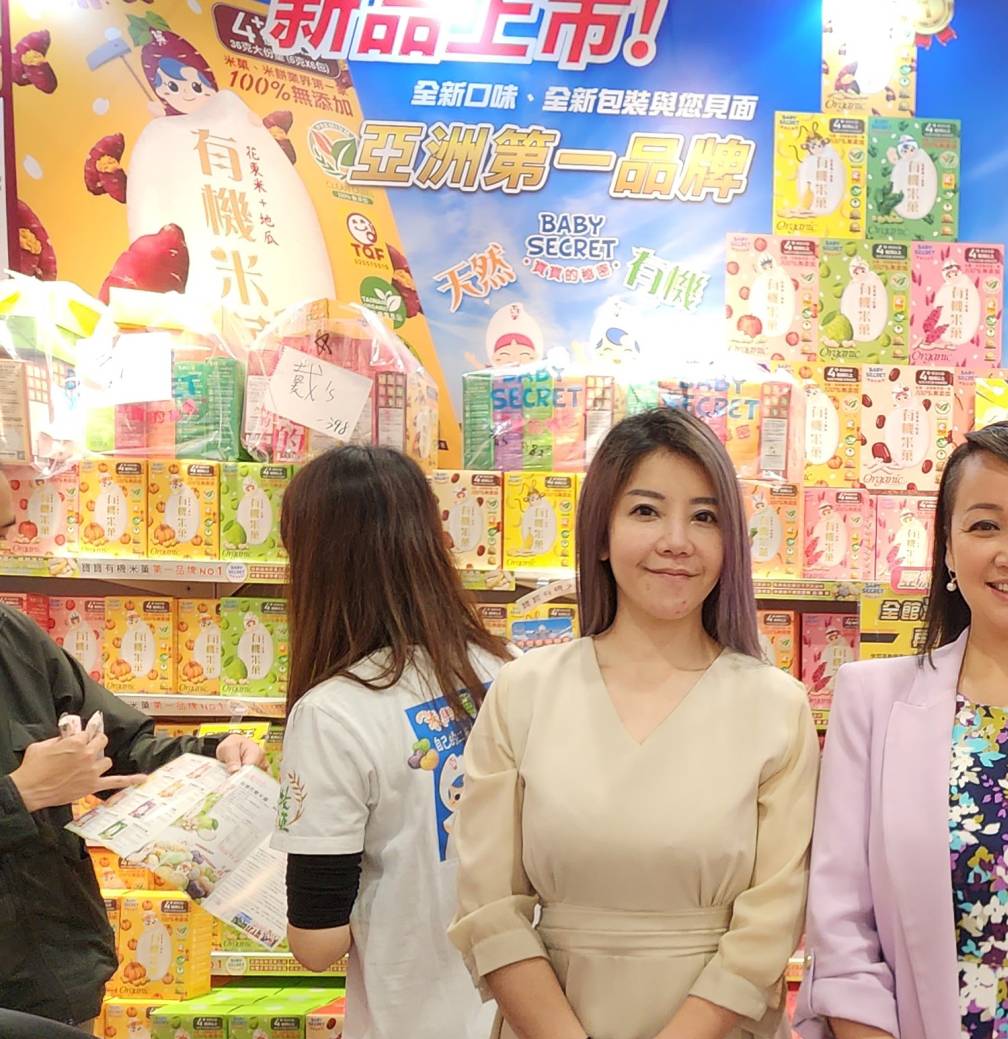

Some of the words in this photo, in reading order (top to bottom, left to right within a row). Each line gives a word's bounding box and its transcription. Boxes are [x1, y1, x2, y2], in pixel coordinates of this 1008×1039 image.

[411, 80, 758, 120] 全新口味、全新包裝與您見面
[350, 122, 754, 201] 亞洲第一品牌
[539, 212, 605, 235] BABY
[350, 242, 385, 261] TQF
[526, 236, 617, 259] SECRET
[437, 243, 516, 311] 天然
[626, 248, 710, 310] 有機
[490, 386, 583, 409] SECRET
